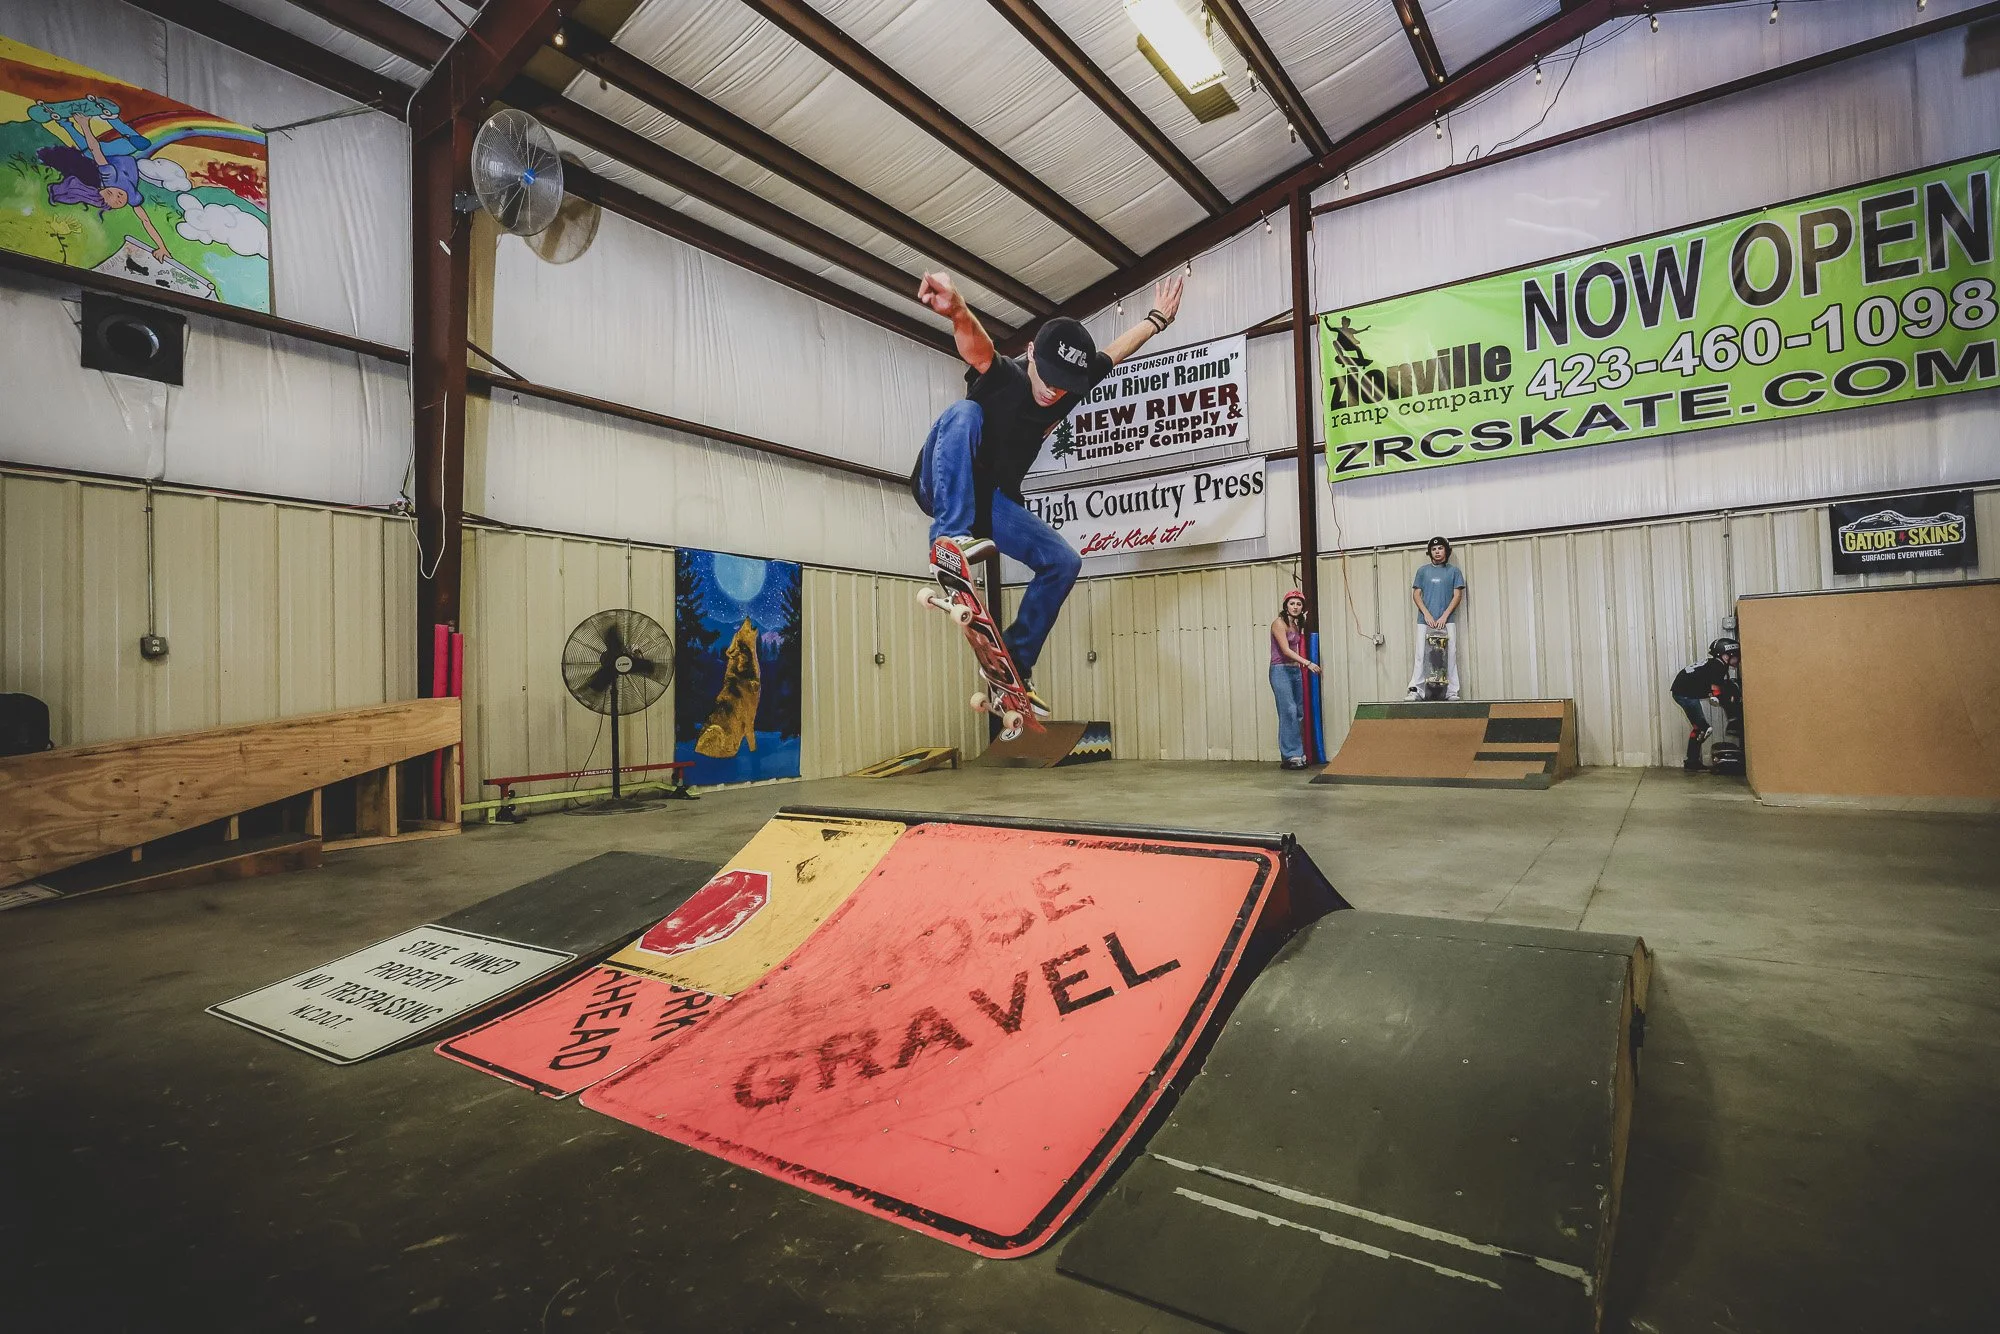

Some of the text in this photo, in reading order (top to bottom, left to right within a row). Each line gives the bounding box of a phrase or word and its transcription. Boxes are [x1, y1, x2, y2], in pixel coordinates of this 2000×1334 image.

[1523, 171, 1994, 352] NOW OPEN
[1130, 355, 1174, 373] SPONSOR
[1176, 352, 1188, 363] OF
[1189, 347, 1208, 360] THE
[1526, 278, 1999, 401] 423-460-1098
[1121, 371, 1169, 397] River
[1330, 342, 1512, 411] zionville
[1075, 404, 1244, 448] Building Supply &
[1076, 383, 1240, 434] NEW RIVER
[1331, 385, 1514, 428] ramp company
[1334, 339, 1999, 475] ZRCSKATE.COM
[1077, 423, 1239, 461] Lumber Company
[1025, 470, 1264, 529] High Country Press
[1080, 520, 1196, 555] "Let's Kick it!"
[1845, 523, 1961, 551] GATOR SKINS
[1862, 553, 1896, 562] SURFACING
[364, 961, 464, 992] PROPERTY
[398, 940, 521, 976] STATE OWNED
[288, 1004, 354, 1029] N.C.D.O.T.
[292, 973, 443, 1024] NO TRESPASSING
[549, 969, 642, 1071] AHEAD
[732, 931, 1182, 1109] GRAVEL
